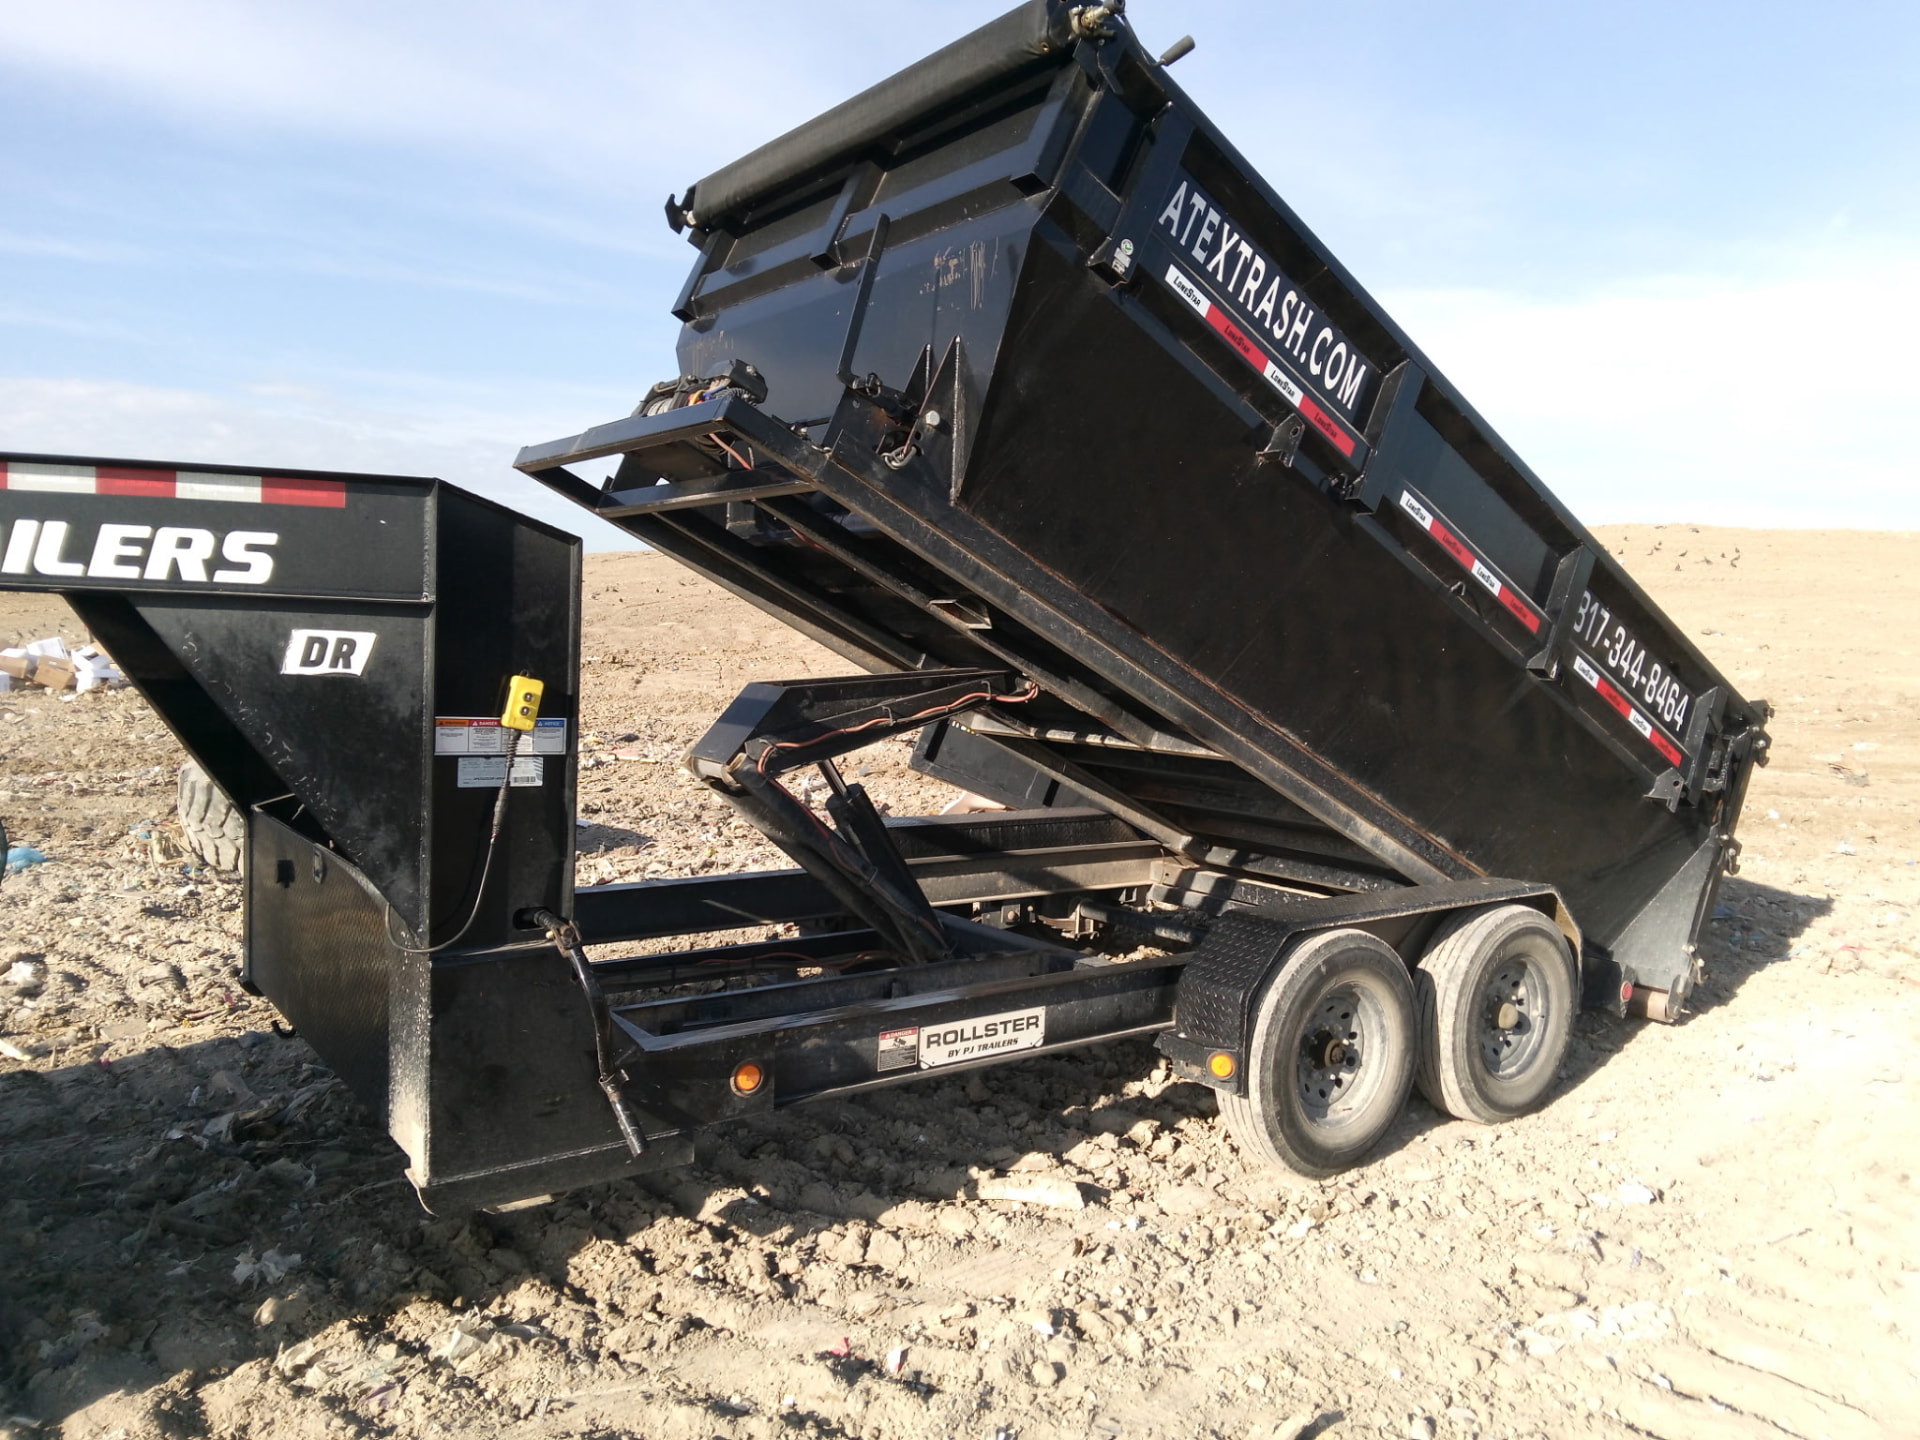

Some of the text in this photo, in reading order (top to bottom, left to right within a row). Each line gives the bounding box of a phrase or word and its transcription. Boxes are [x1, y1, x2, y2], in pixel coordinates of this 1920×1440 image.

[1158, 180, 1367, 410] ATEXTRASH.COM
[299, 636, 357, 669] DR
[1573, 590, 1689, 732] 817-344-8464
[926, 1014, 1040, 1049] ROLLSTER
[947, 1037, 1019, 1058] BY PJ TRAILERS
